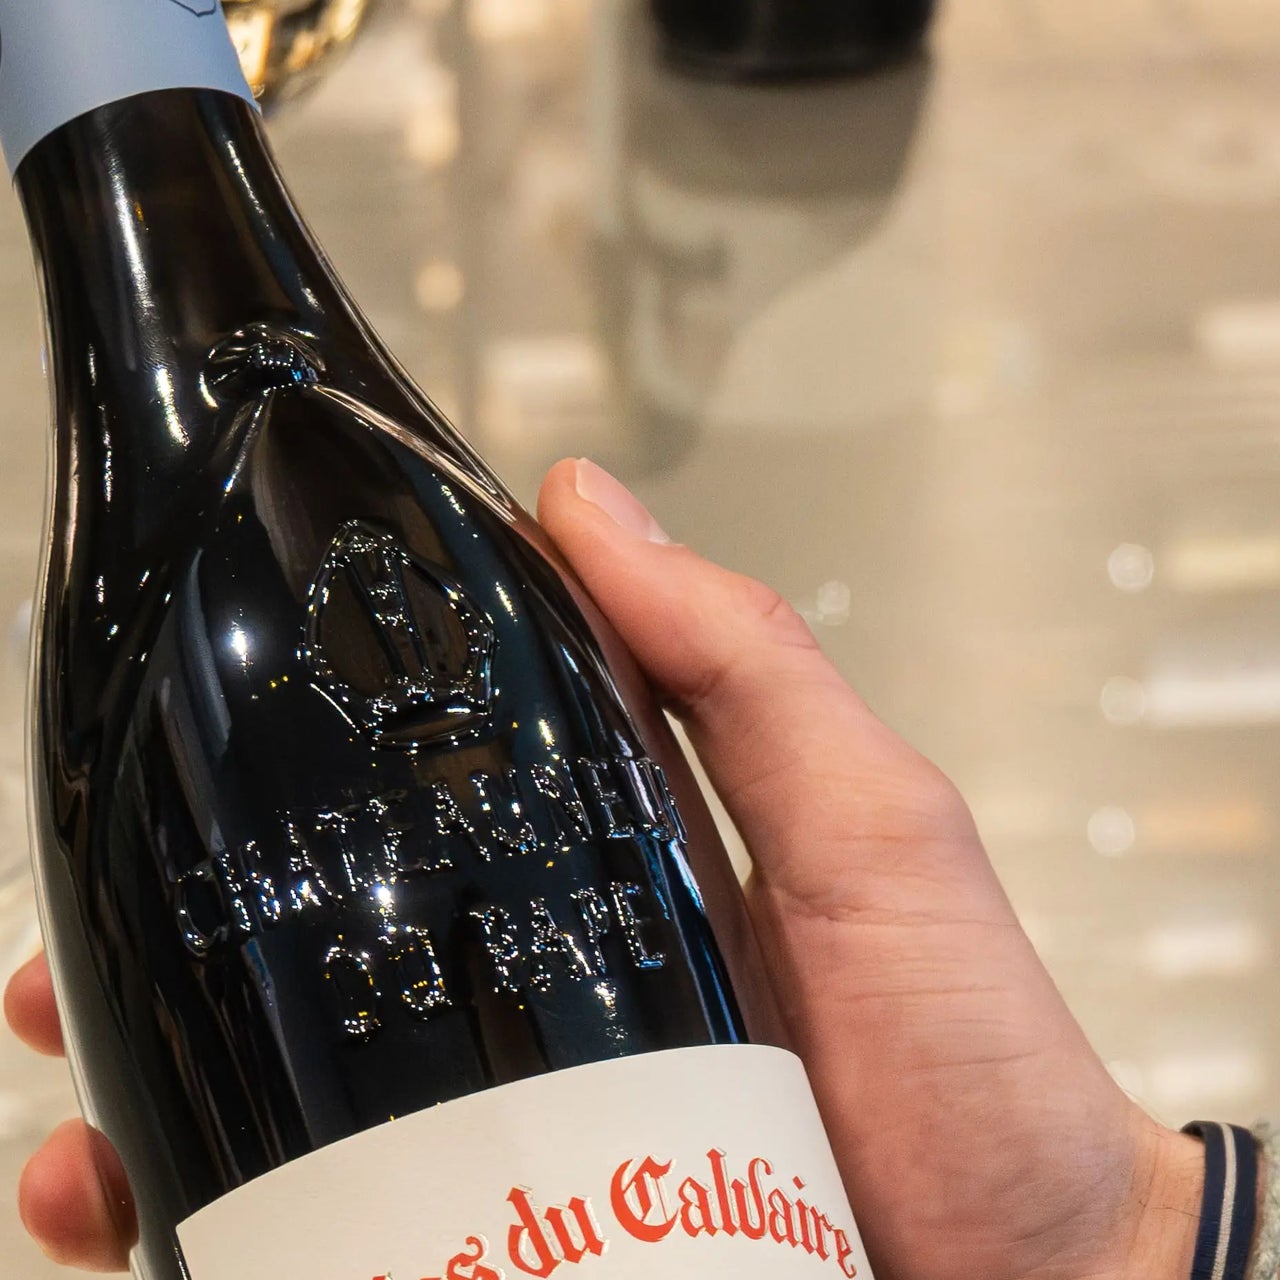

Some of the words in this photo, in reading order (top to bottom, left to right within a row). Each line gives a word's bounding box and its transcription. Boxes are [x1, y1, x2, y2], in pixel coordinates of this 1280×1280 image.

[469, 881, 666, 994] PAPE
[506, 1185, 609, 1278] du
[609, 1147, 857, 1279] Calvaire
